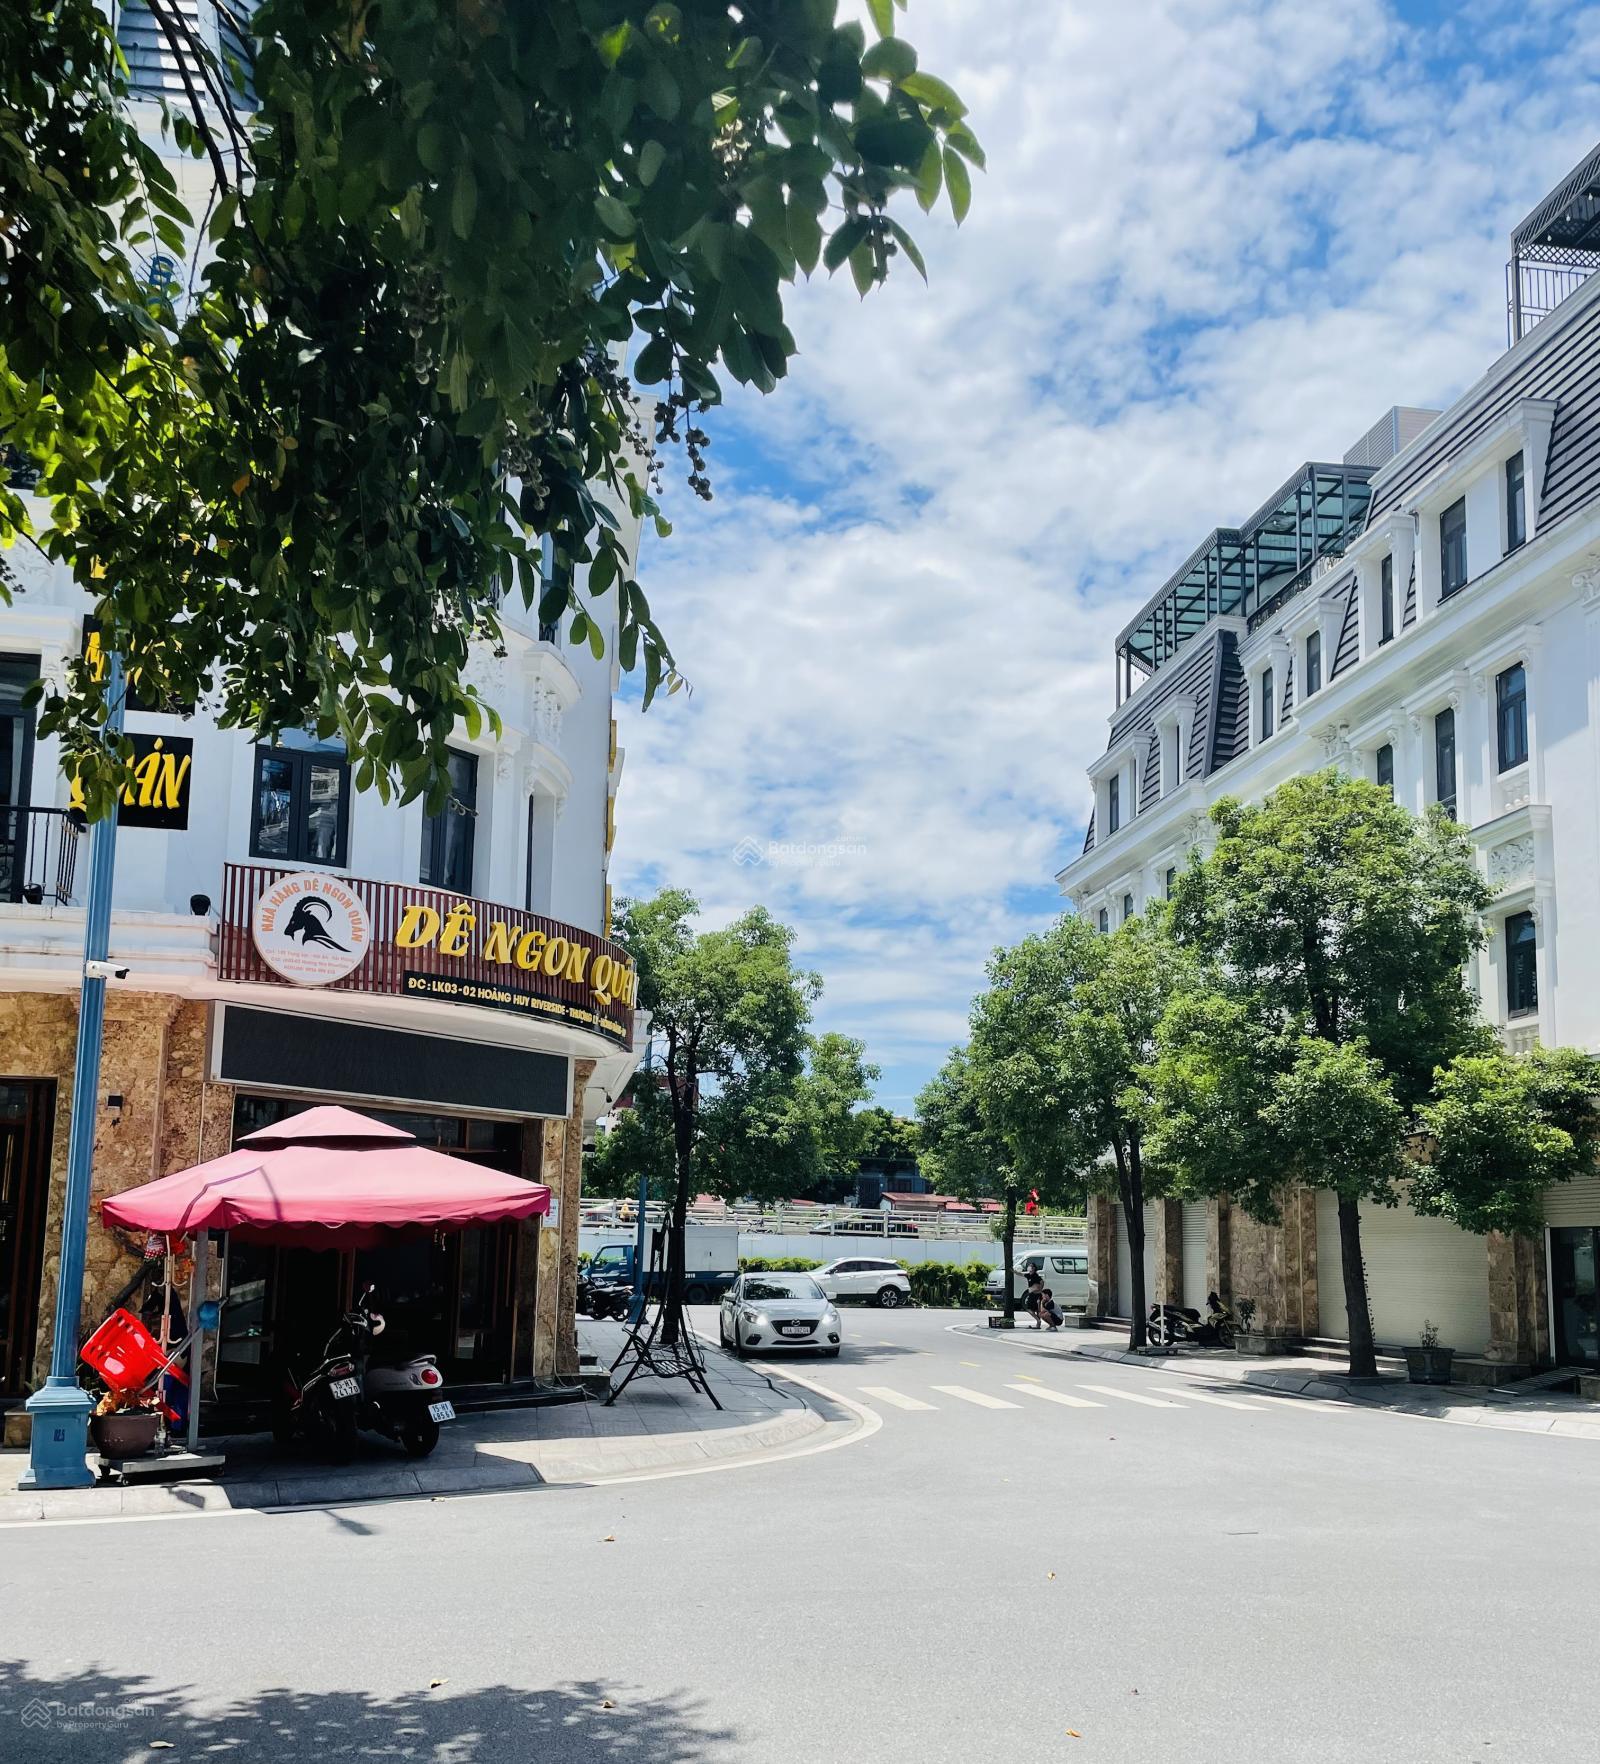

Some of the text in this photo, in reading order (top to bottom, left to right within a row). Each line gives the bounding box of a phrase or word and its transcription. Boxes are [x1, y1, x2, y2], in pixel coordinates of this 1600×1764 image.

[69, 737, 192, 811] ÁN
[261, 907, 277, 932] NHÀ
[270, 882, 301, 907] HÀNG
[303, 878, 319, 892] DÊ
[322, 882, 354, 910] NGON
[395, 902, 476, 957] DÊ
[484, 921, 591, 984] NGON
[477, 987, 511, 1003] HOÀNG
[513, 993, 530, 1006] HUY
[531, 998, 566, 1016] RIVERSIDE
